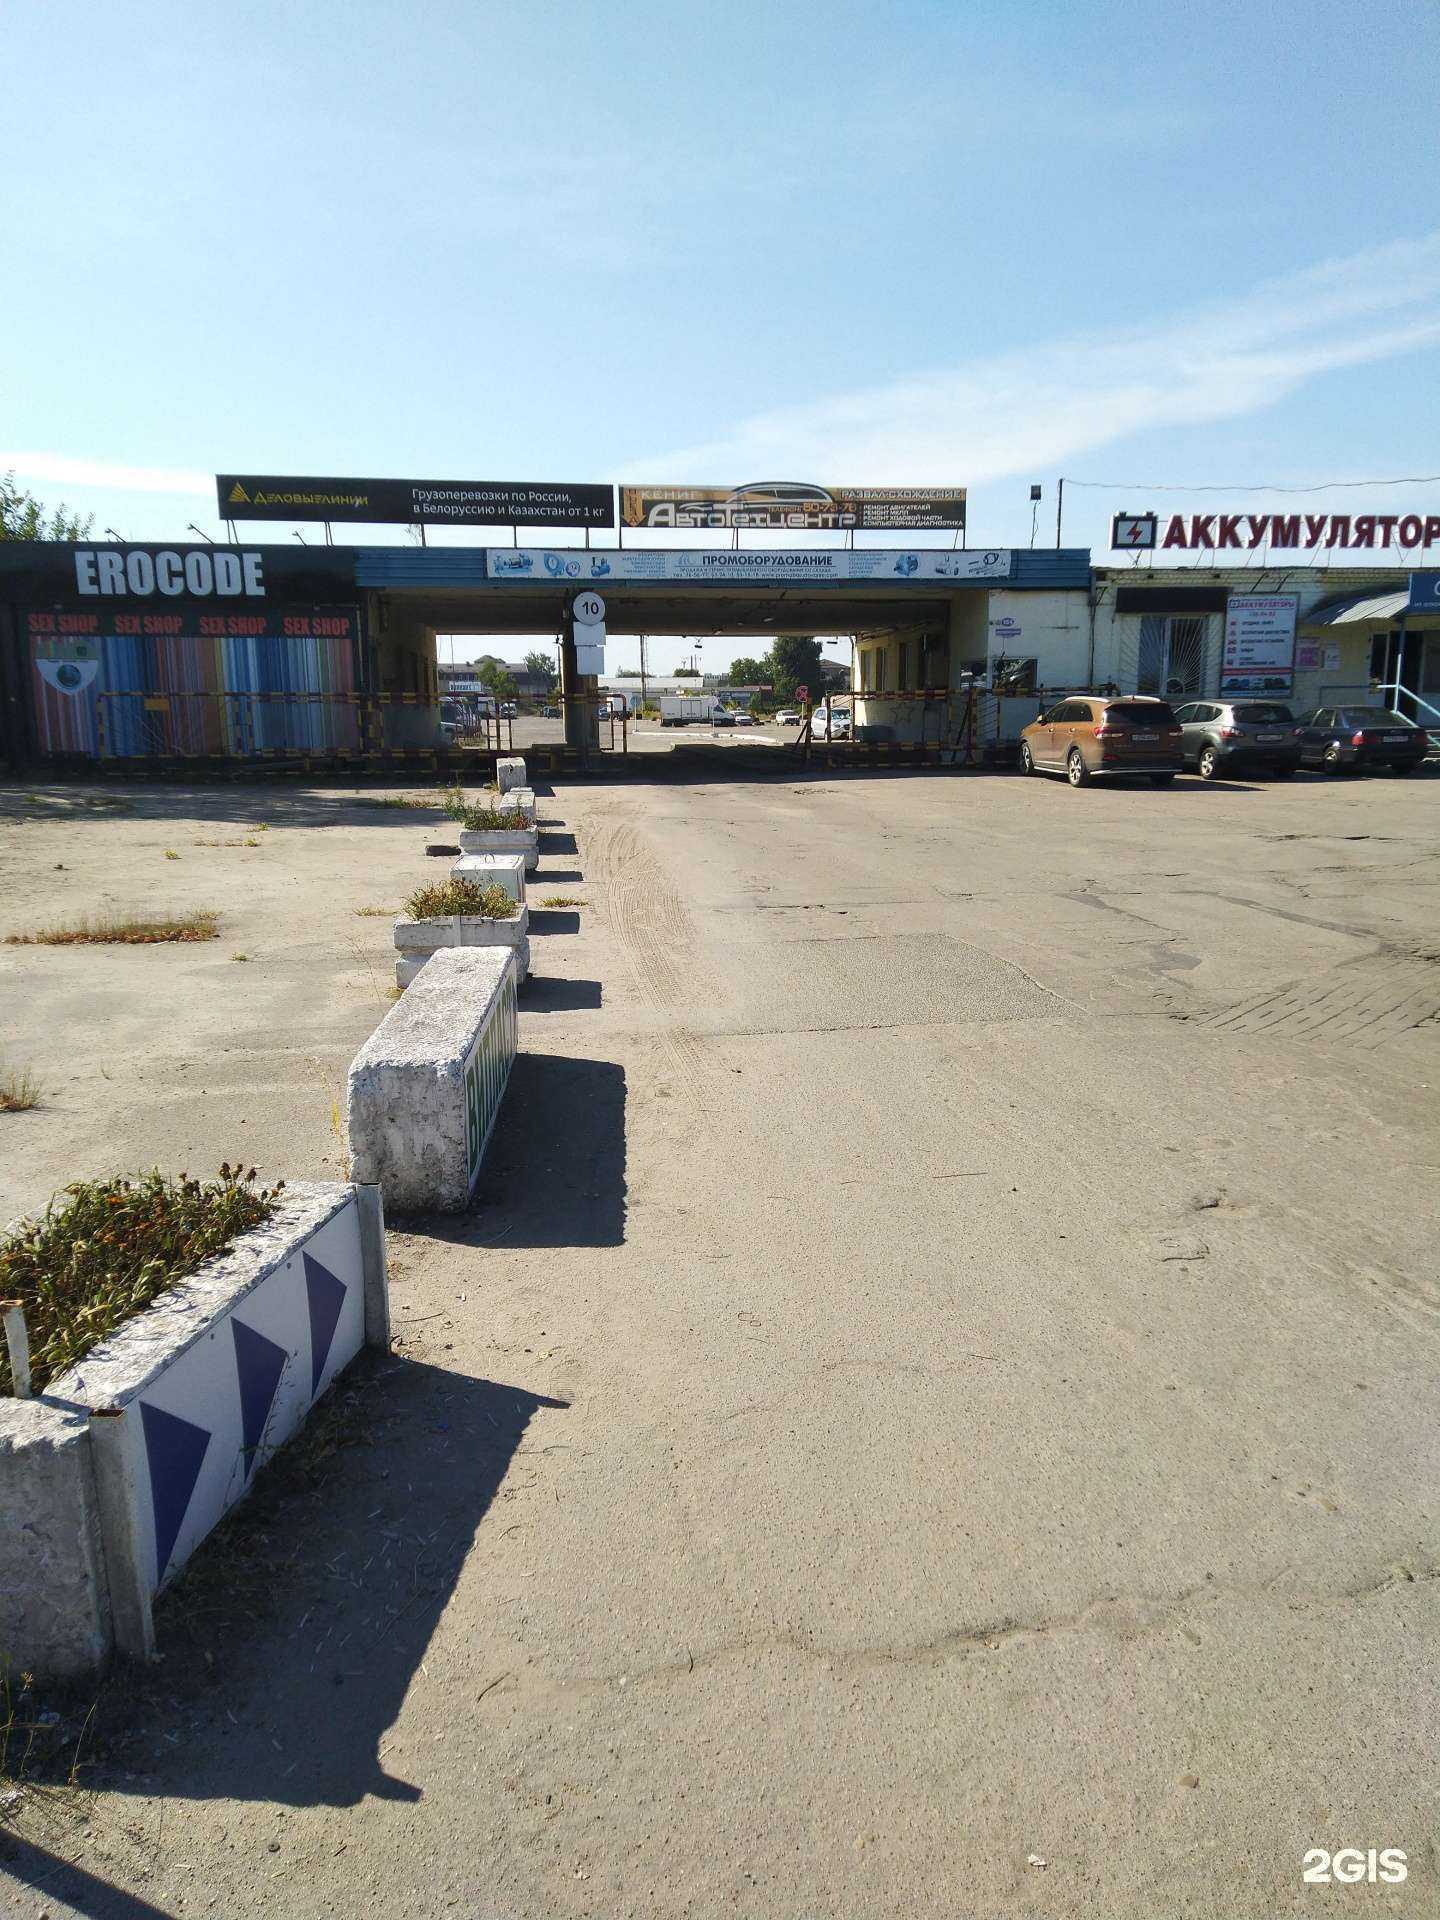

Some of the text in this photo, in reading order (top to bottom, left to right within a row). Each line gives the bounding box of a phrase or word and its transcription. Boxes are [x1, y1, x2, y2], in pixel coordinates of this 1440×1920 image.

[412, 488, 573, 504] Грузоперевозки по России,
[413, 503, 605, 517] в Белоруссию и Казахстан от 1 кг
[702, 555, 833, 566] ПРОМОБОРУДОВАНИЕ
[75, 551, 265, 597] EROCODE
[582, 602, 599, 615] 10
[28, 613, 98, 632] SEX SHOP
[114, 615, 183, 634] SEX SHOP
[200, 616, 266, 635] SEX SHOP
[283, 616, 350, 635] SEX SHOP
